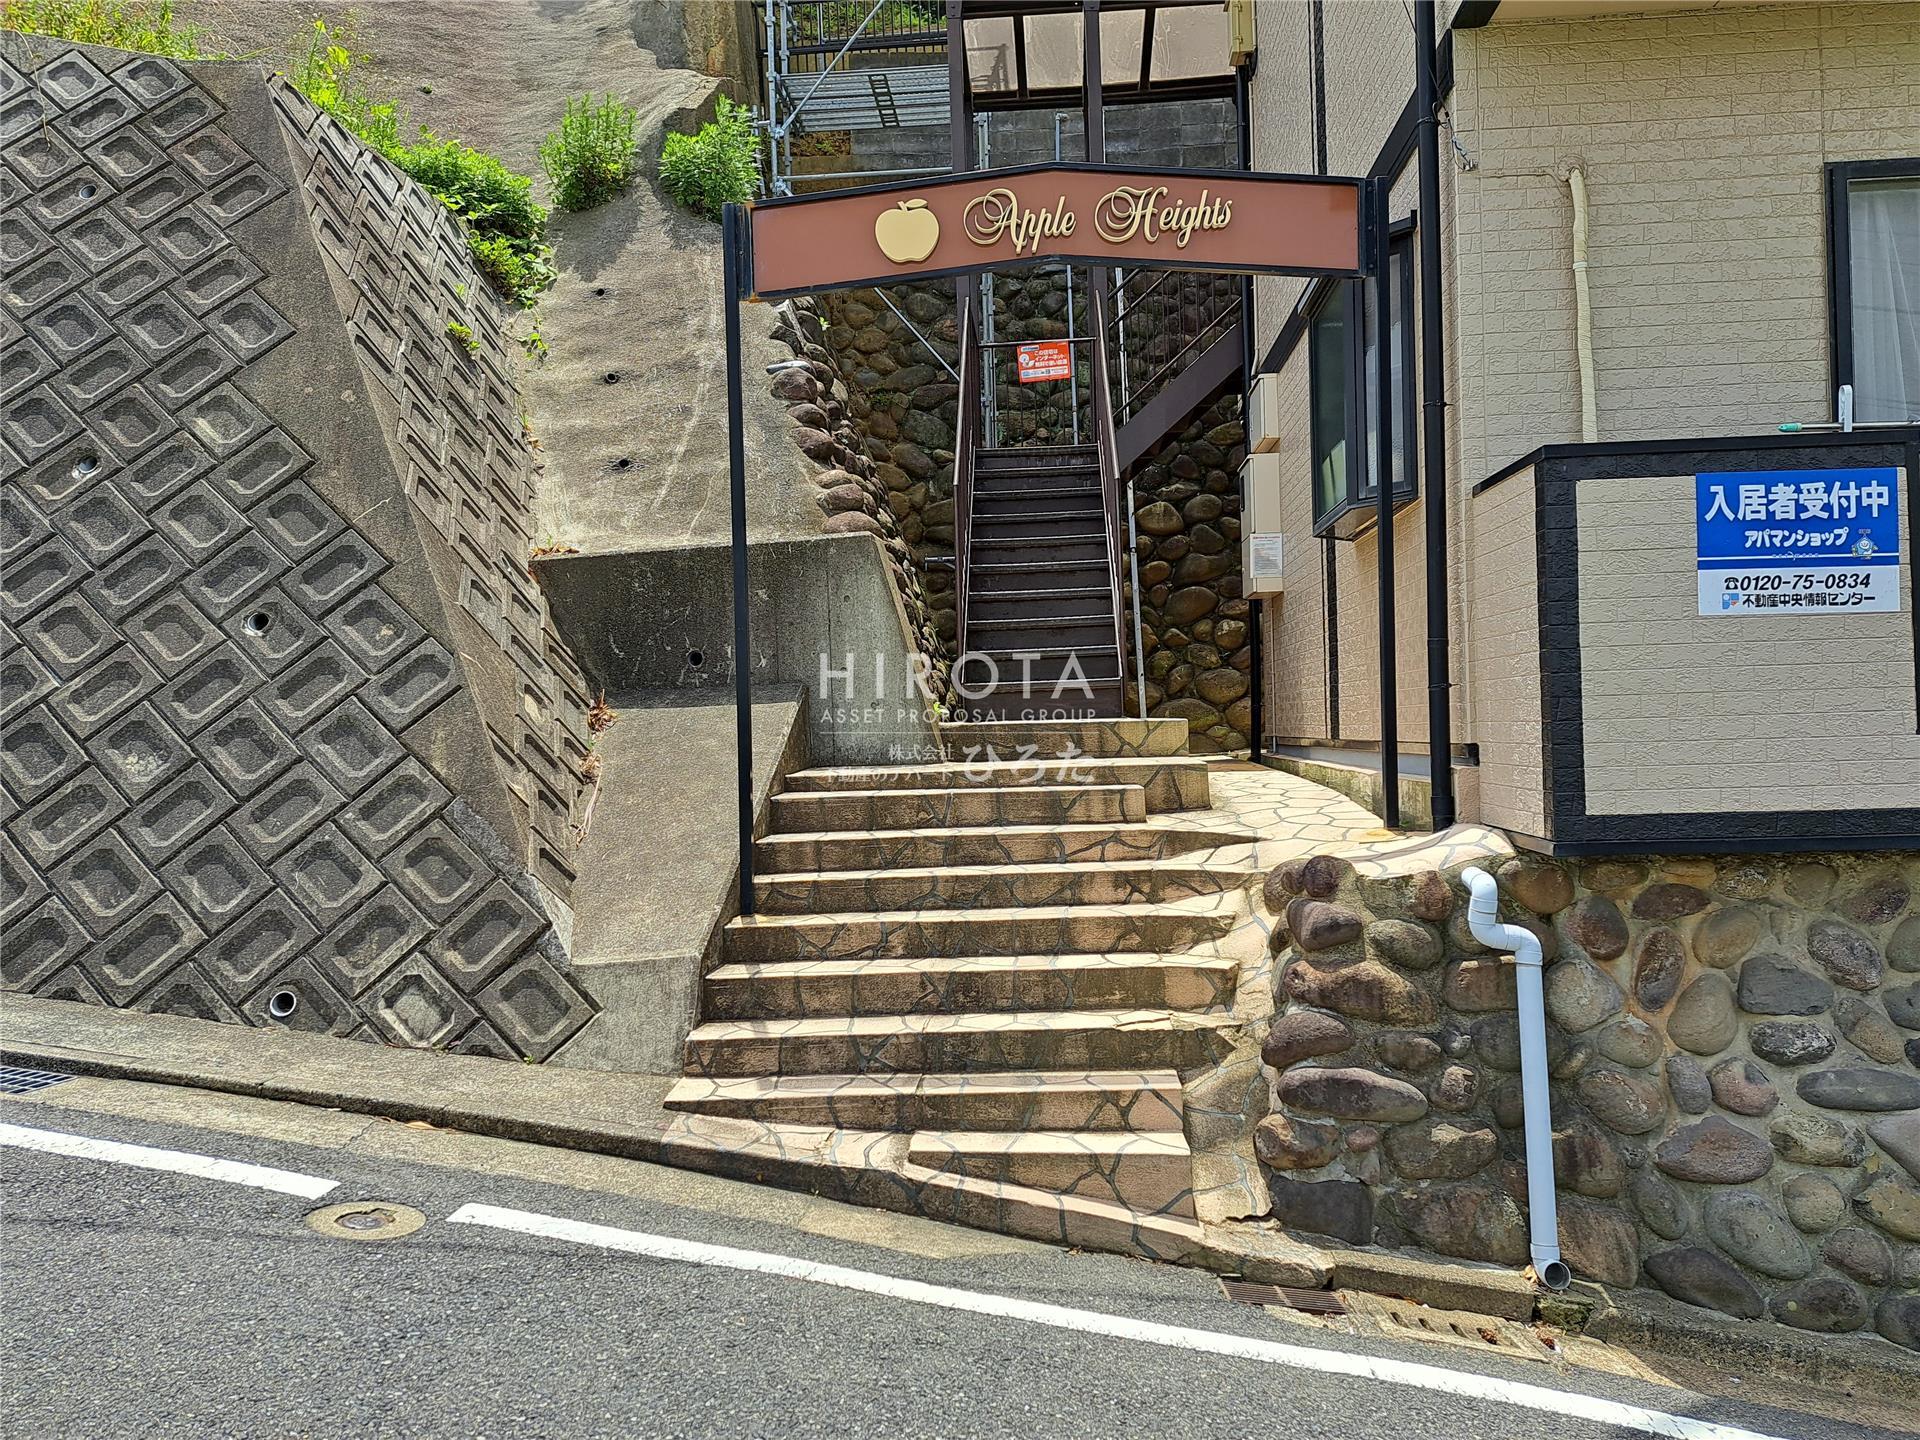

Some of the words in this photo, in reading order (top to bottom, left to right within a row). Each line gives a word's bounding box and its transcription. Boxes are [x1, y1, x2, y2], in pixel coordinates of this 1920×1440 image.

[963, 188, 1077, 255] Apple
[1094, 186, 1233, 249] Heights
[1704, 480, 1889, 522] 入居者受付中
[1744, 526, 1849, 548] アパマンショップ
[1740, 573, 1871, 591] 0120-75-0834
[1742, 592, 1876, 608] 不動産中央情報センター
